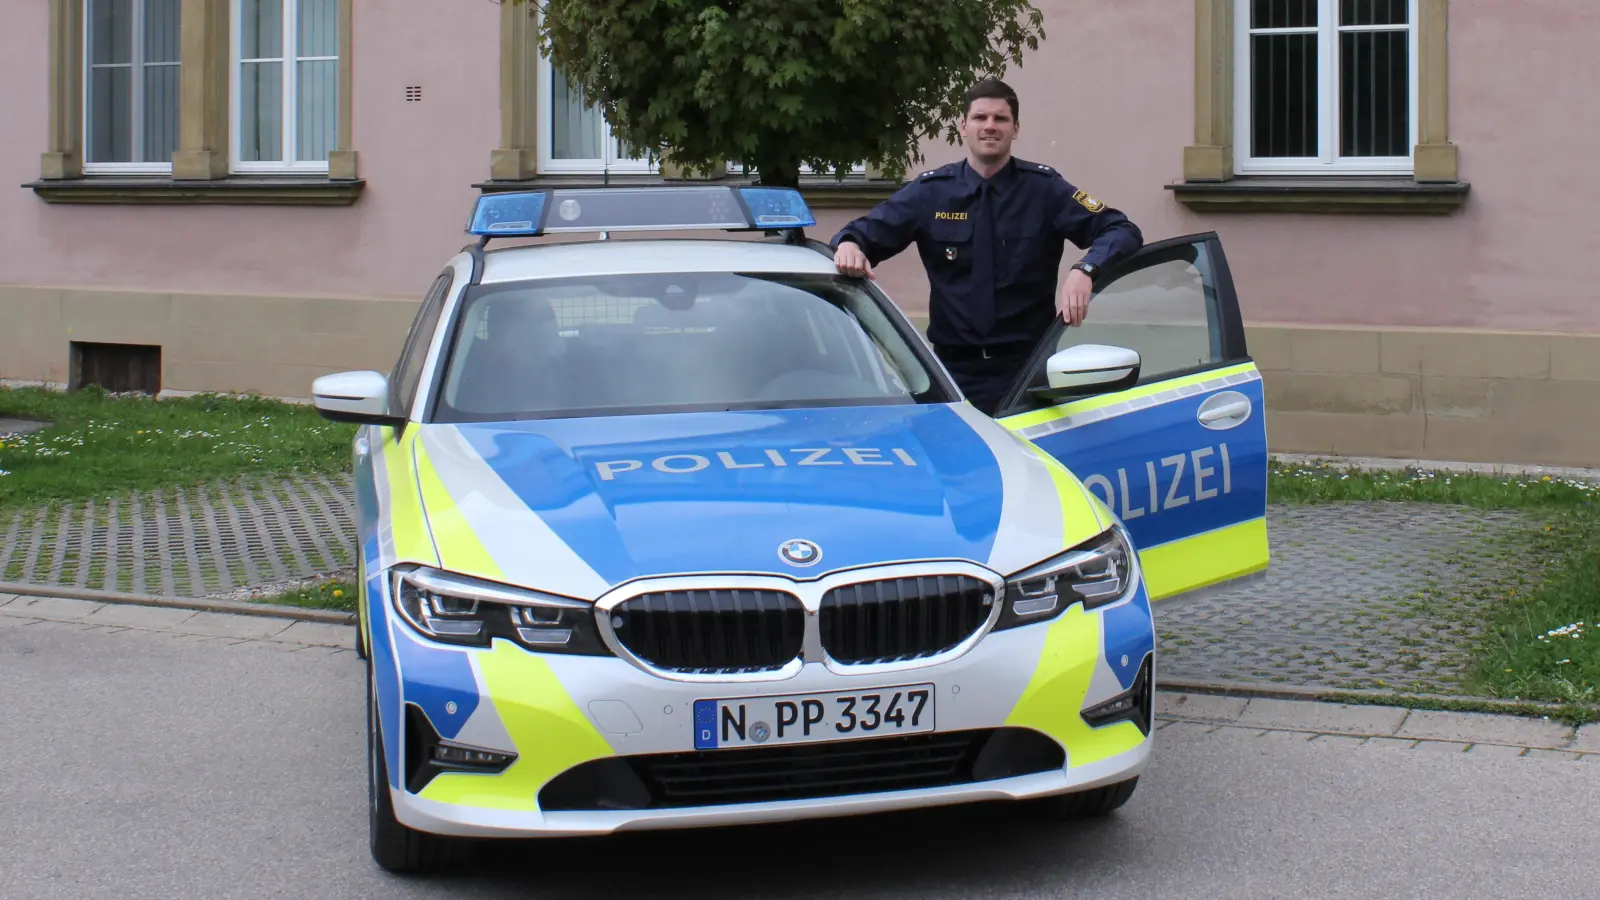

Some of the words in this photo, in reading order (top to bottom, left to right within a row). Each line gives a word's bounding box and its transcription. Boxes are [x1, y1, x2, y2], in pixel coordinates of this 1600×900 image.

[934, 211, 968, 220] POLIZEI
[594, 447, 918, 482] POLIZEI
[1083, 442, 1231, 521] OLIZEI
[721, 704, 747, 742] N
[775, 698, 825, 738] PP
[835, 689, 929, 733] 3347
[702, 729, 711, 741] D
